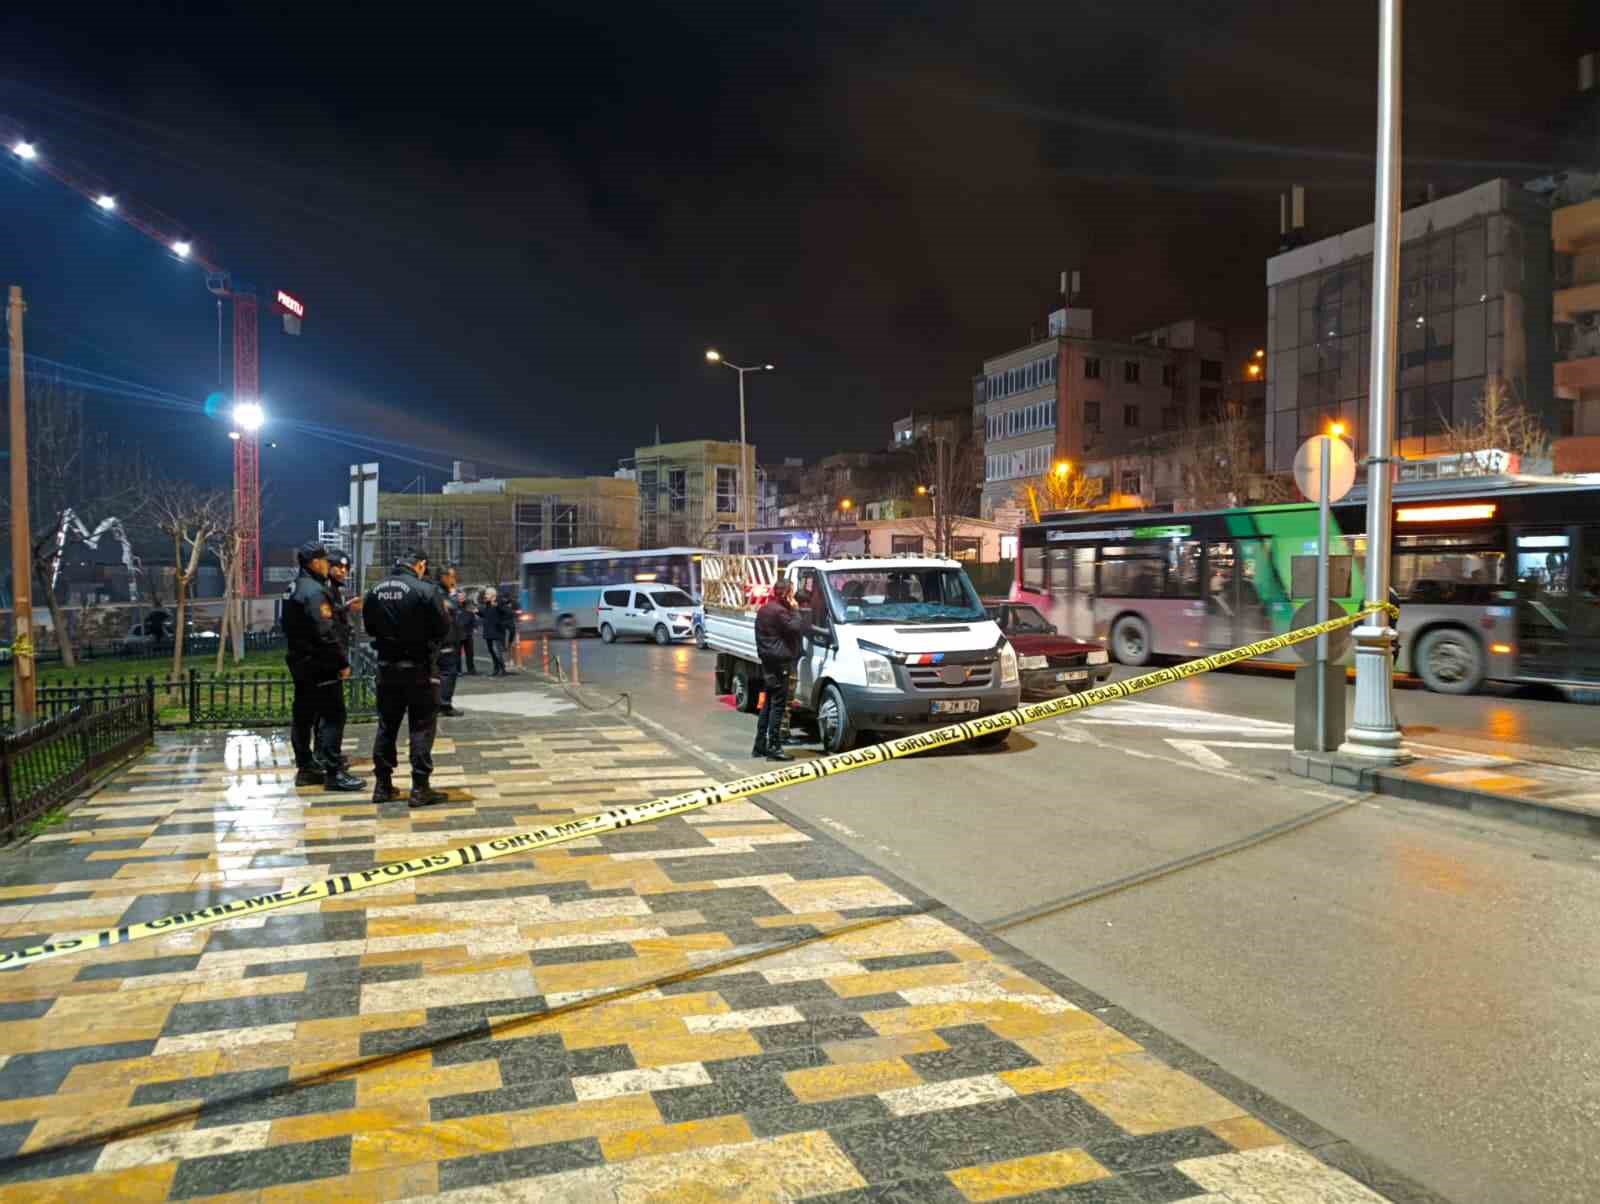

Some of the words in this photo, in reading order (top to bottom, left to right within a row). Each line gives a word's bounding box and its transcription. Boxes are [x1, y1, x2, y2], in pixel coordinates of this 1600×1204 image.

[145, 886, 318, 929] GIRILMEZ
[360, 855, 450, 882] POLIS
[829, 750, 877, 769] POLIS
[894, 727, 961, 752] GIRILMEZ
[973, 715, 1012, 733] POLIS
